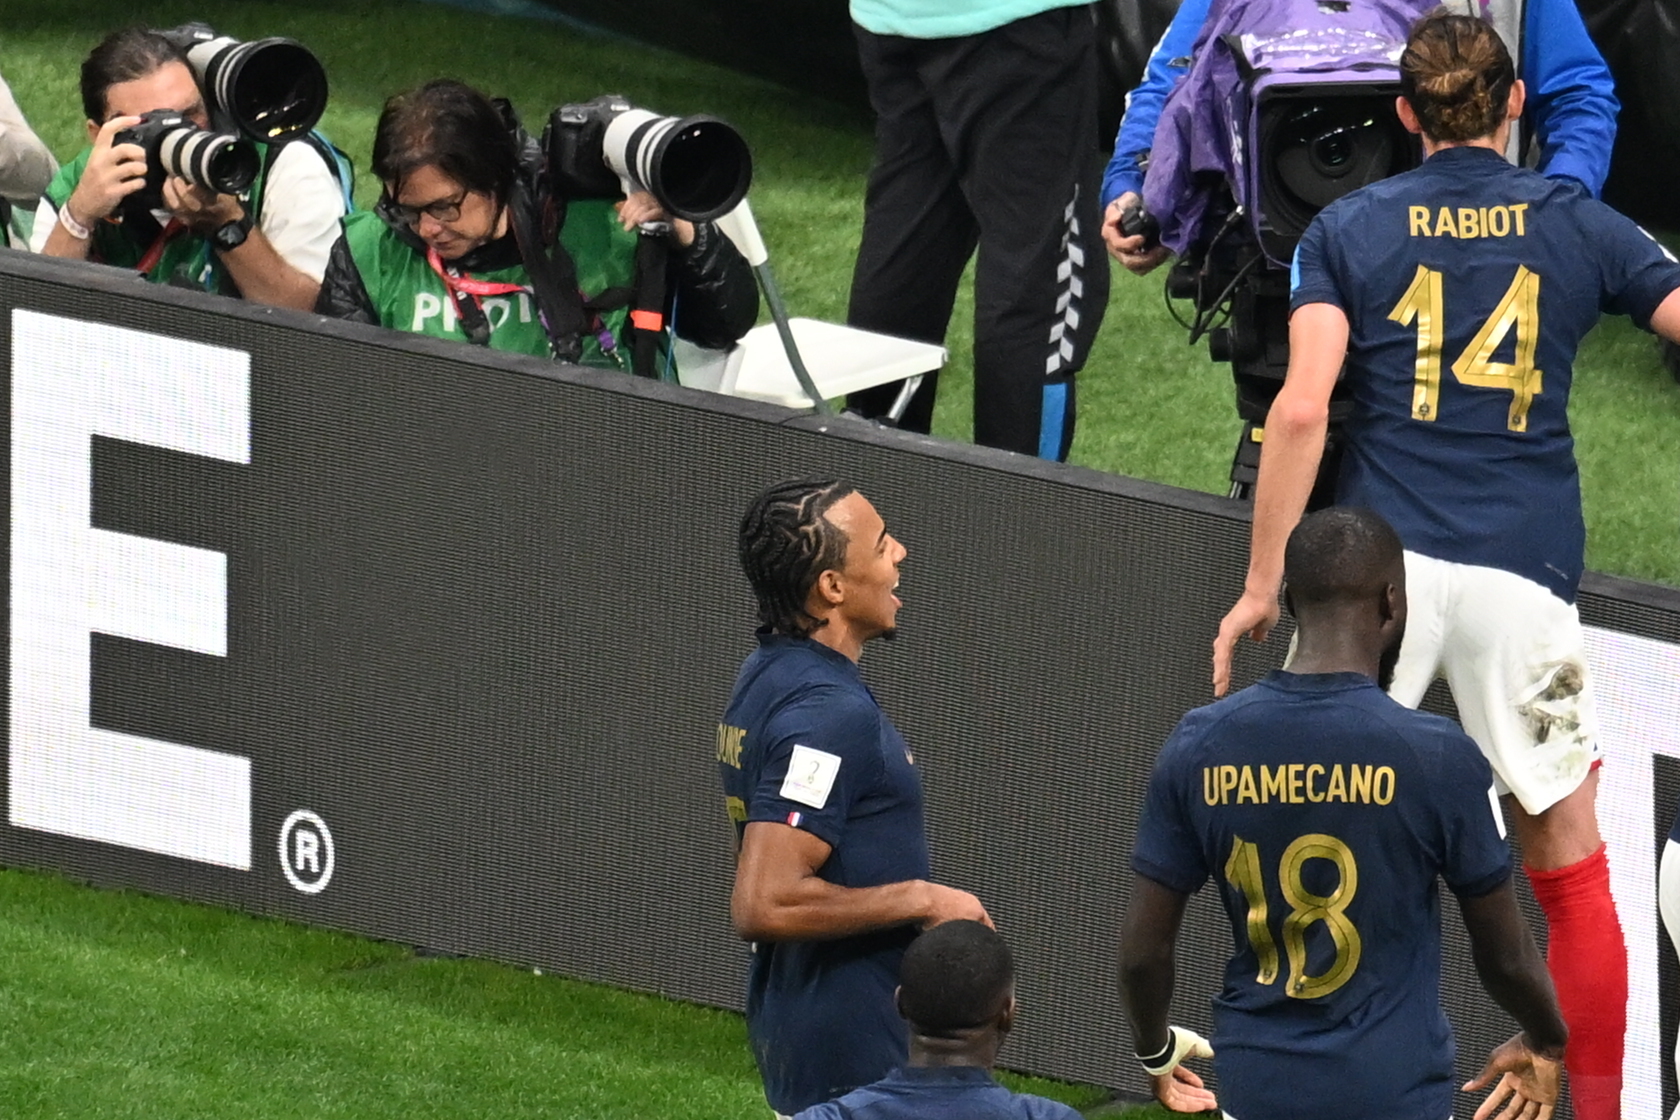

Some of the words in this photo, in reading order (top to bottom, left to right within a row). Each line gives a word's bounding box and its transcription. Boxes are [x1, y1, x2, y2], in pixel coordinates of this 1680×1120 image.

[1408, 203, 1528, 239] RABIOT
[1386, 263, 1543, 433] 14
[1203, 763, 1396, 806] UPAMECANO
[1224, 834, 1361, 999] 18
